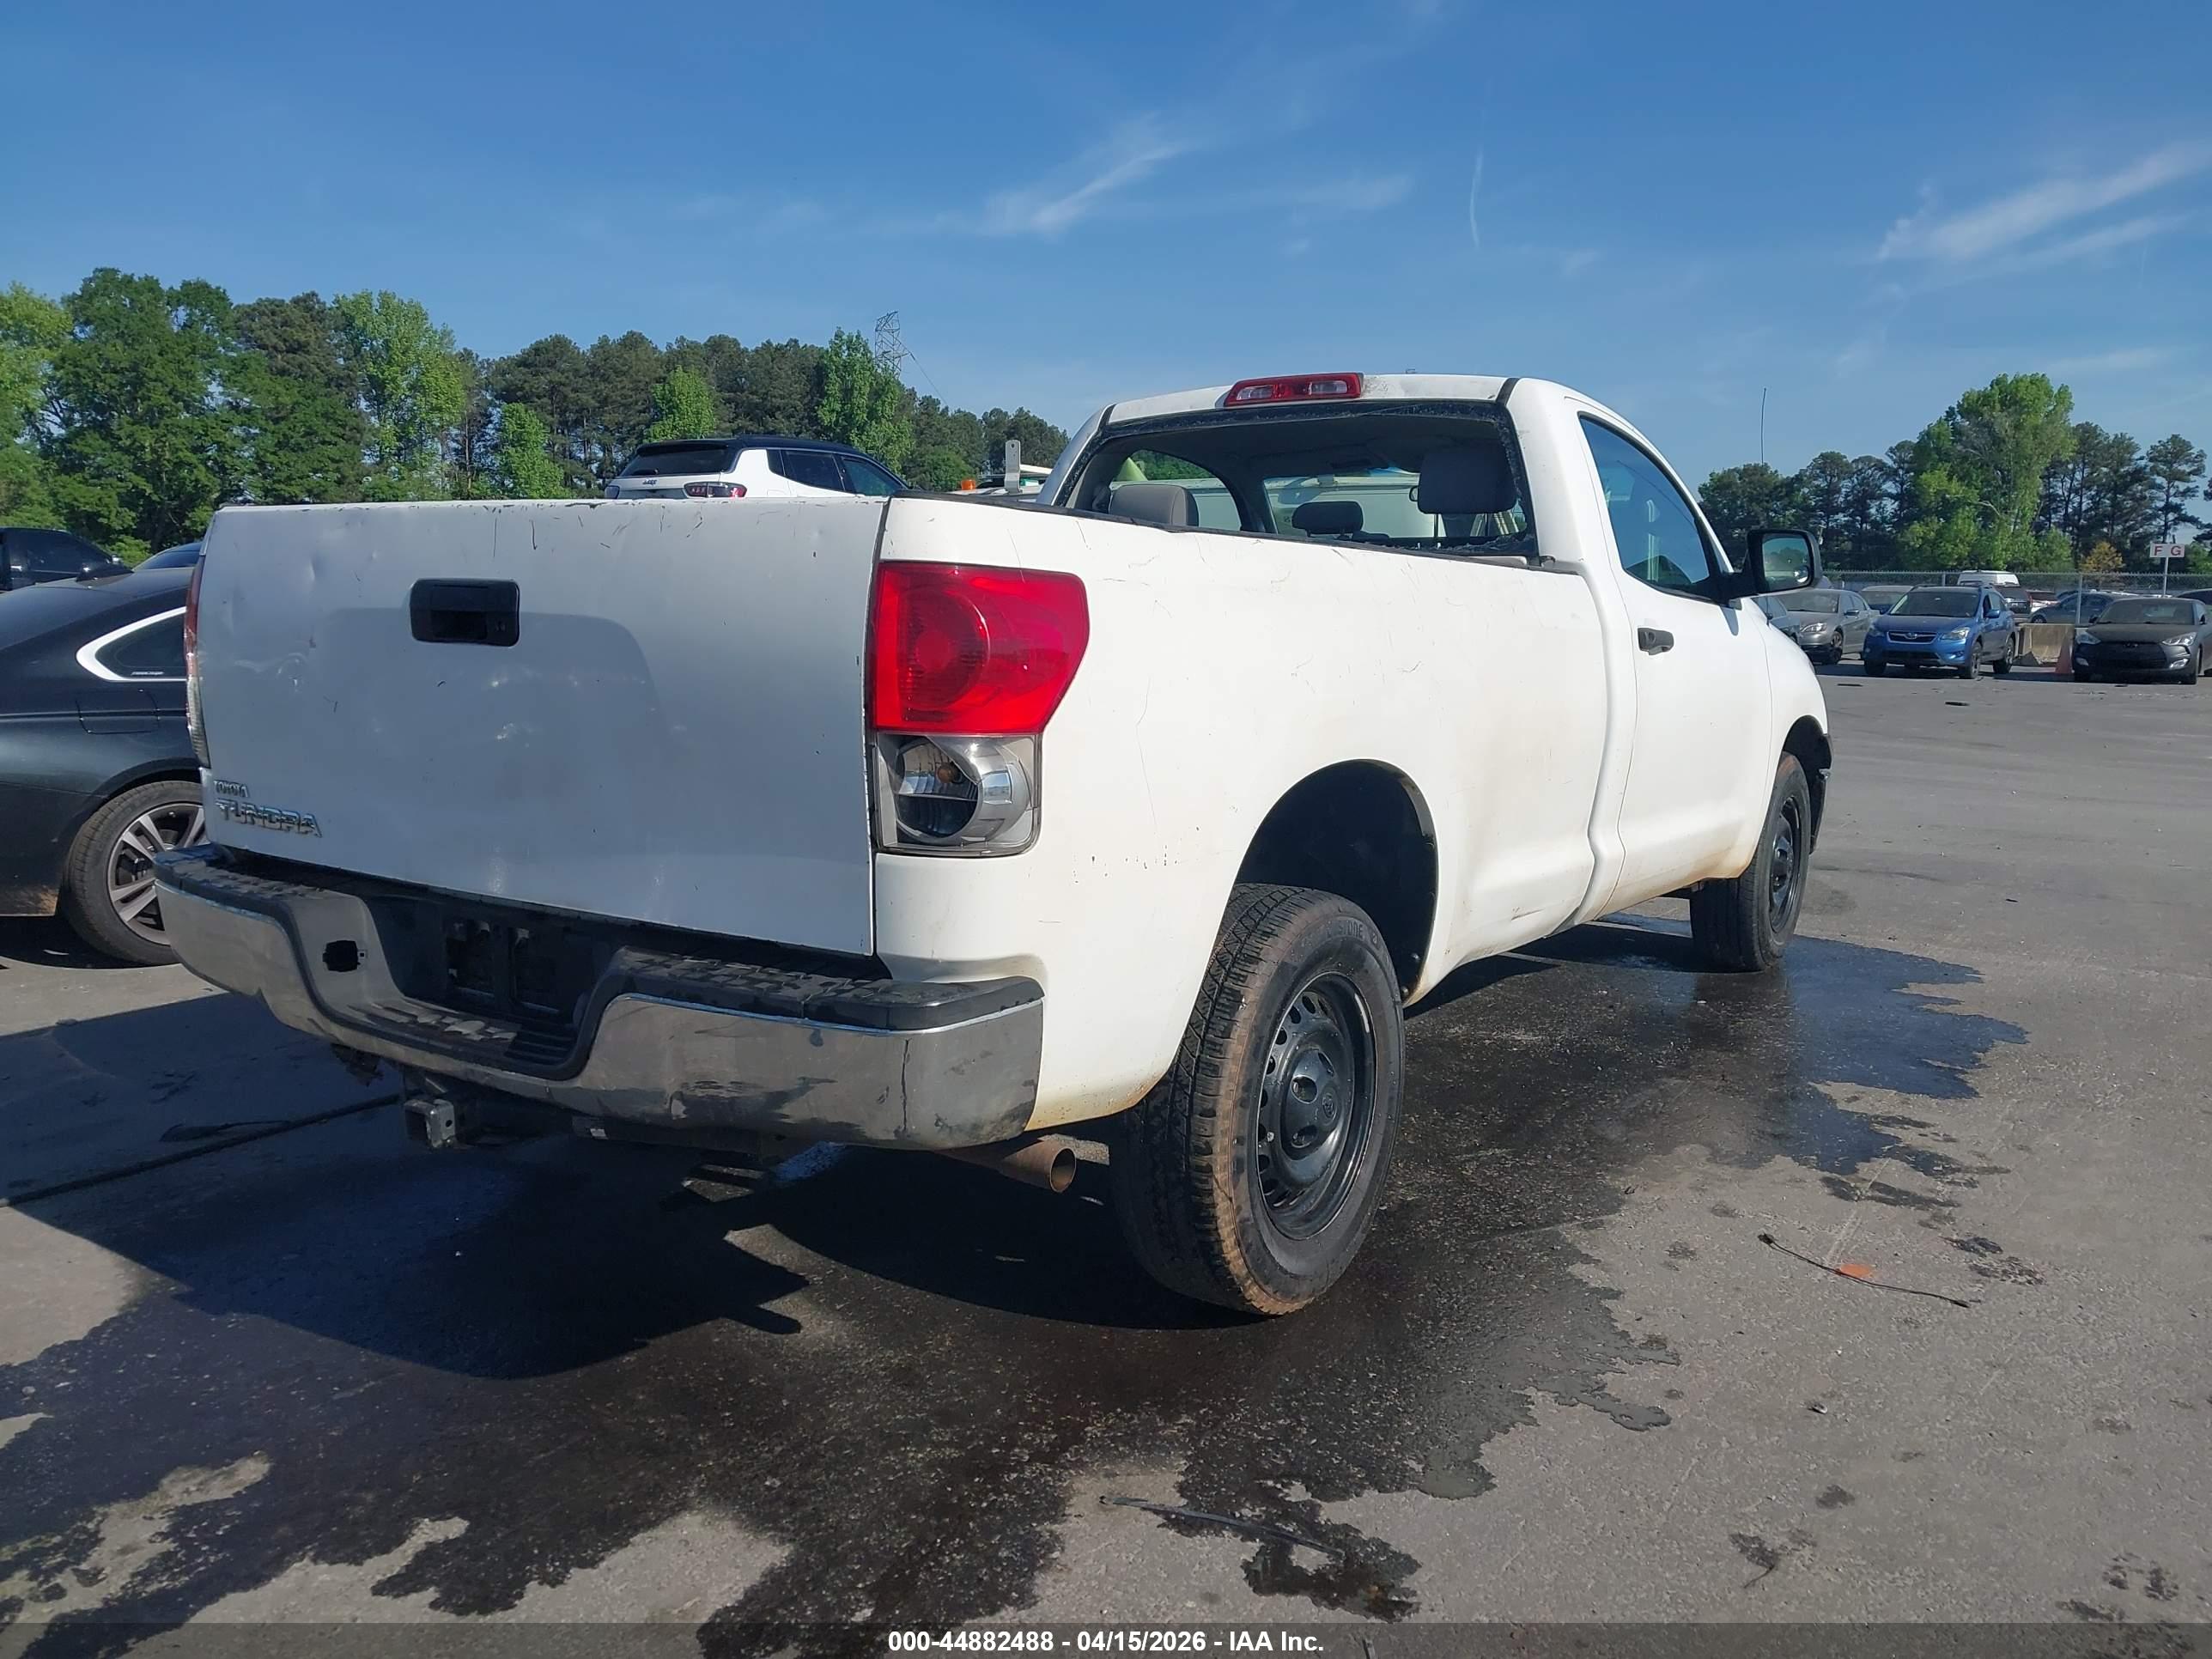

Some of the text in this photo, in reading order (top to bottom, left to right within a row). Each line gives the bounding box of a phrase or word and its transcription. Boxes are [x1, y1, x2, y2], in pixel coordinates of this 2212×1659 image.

[2154, 545, 2182, 556] F G
[213, 779, 249, 798] TOYOTA
[214, 798, 322, 837] TUNDRA
